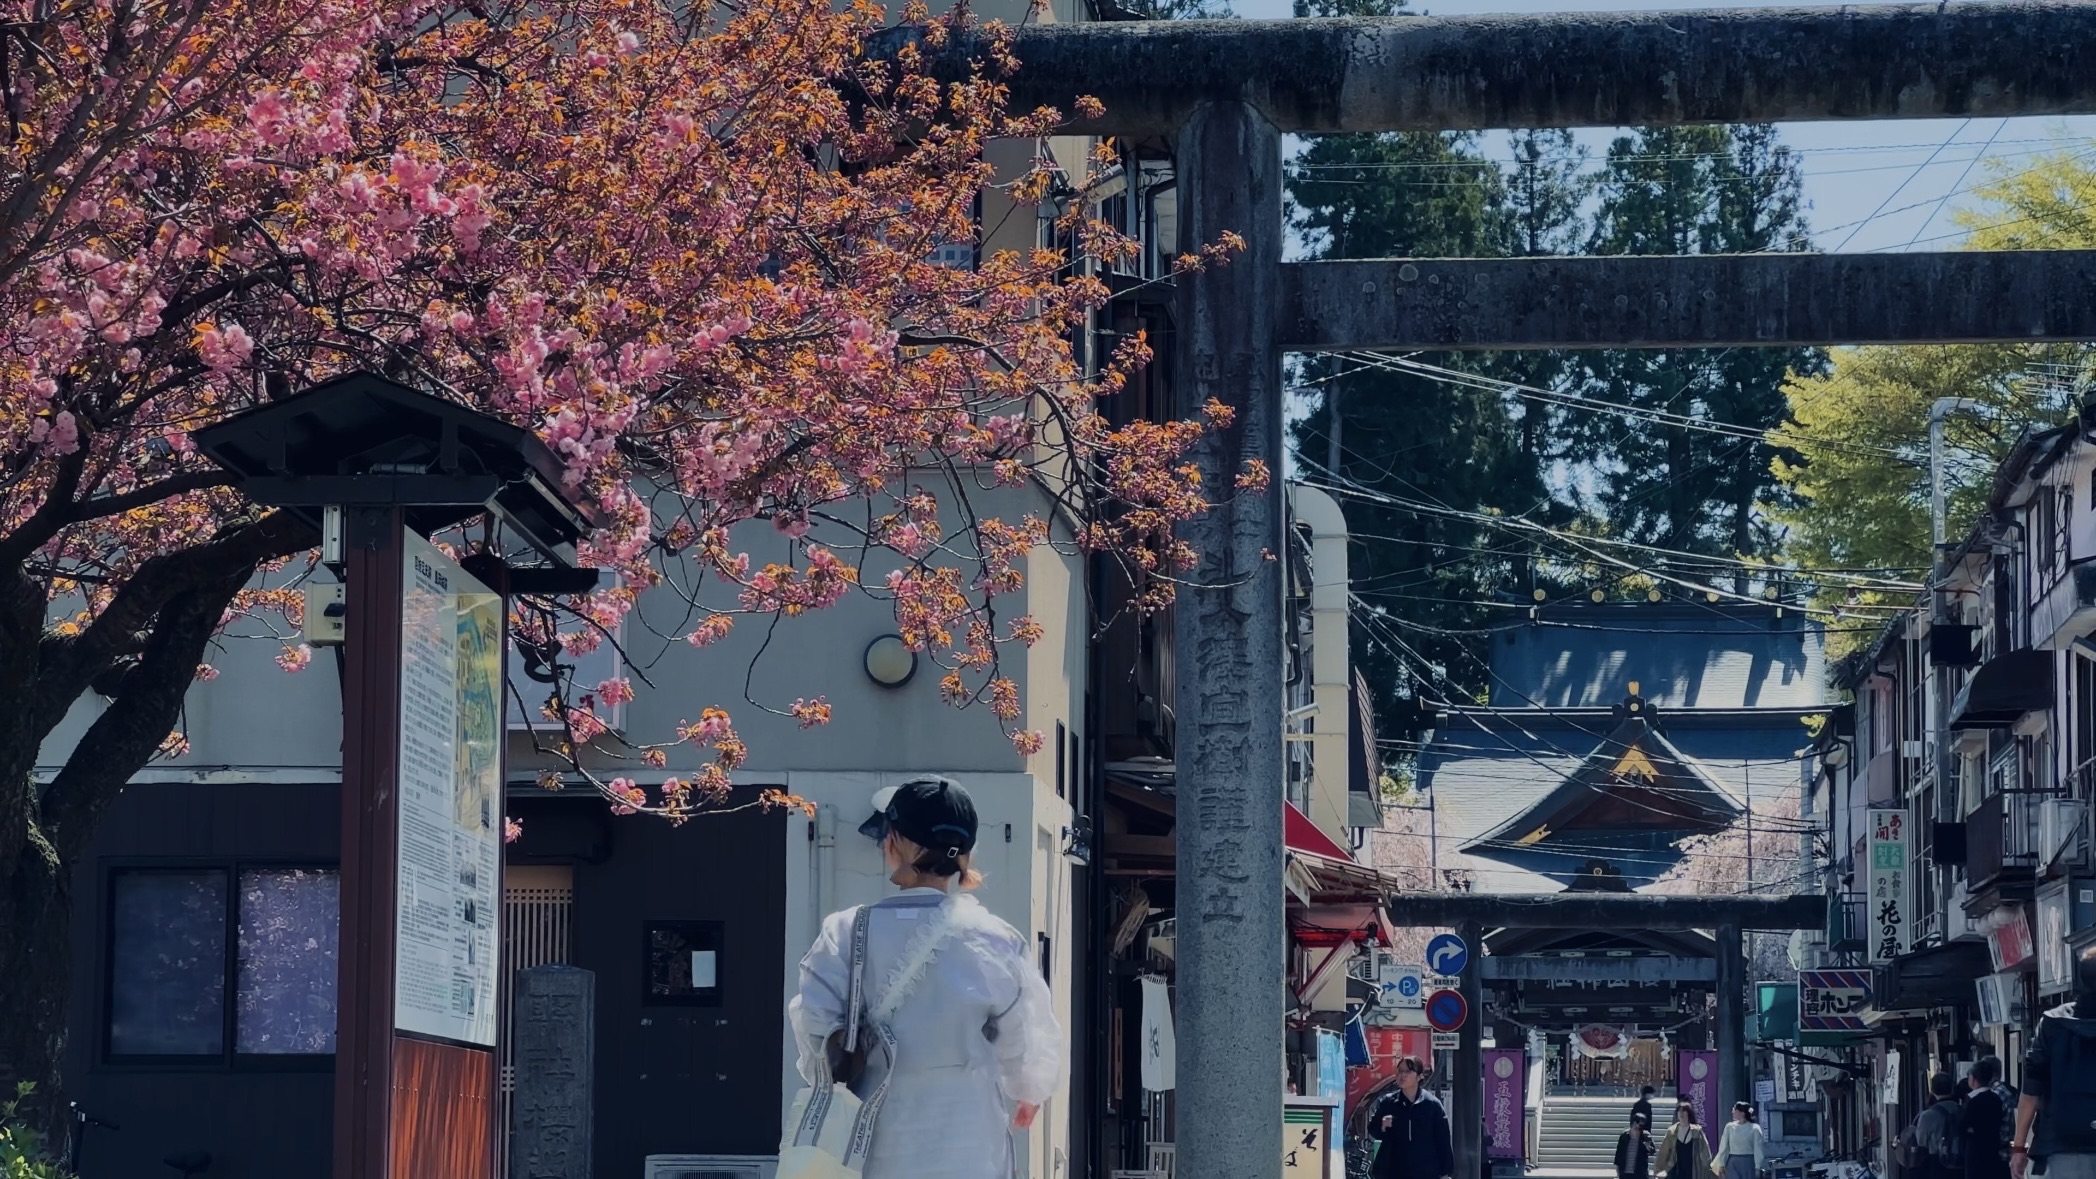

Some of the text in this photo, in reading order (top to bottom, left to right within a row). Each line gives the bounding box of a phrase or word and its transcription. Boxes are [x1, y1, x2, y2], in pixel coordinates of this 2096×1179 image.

[1890, 813, 1902, 840] あさ
[1876, 877, 1887, 899] の店
[1877, 899, 1903, 960] 花の屋
[1805, 989, 1819, 1015] 理容
